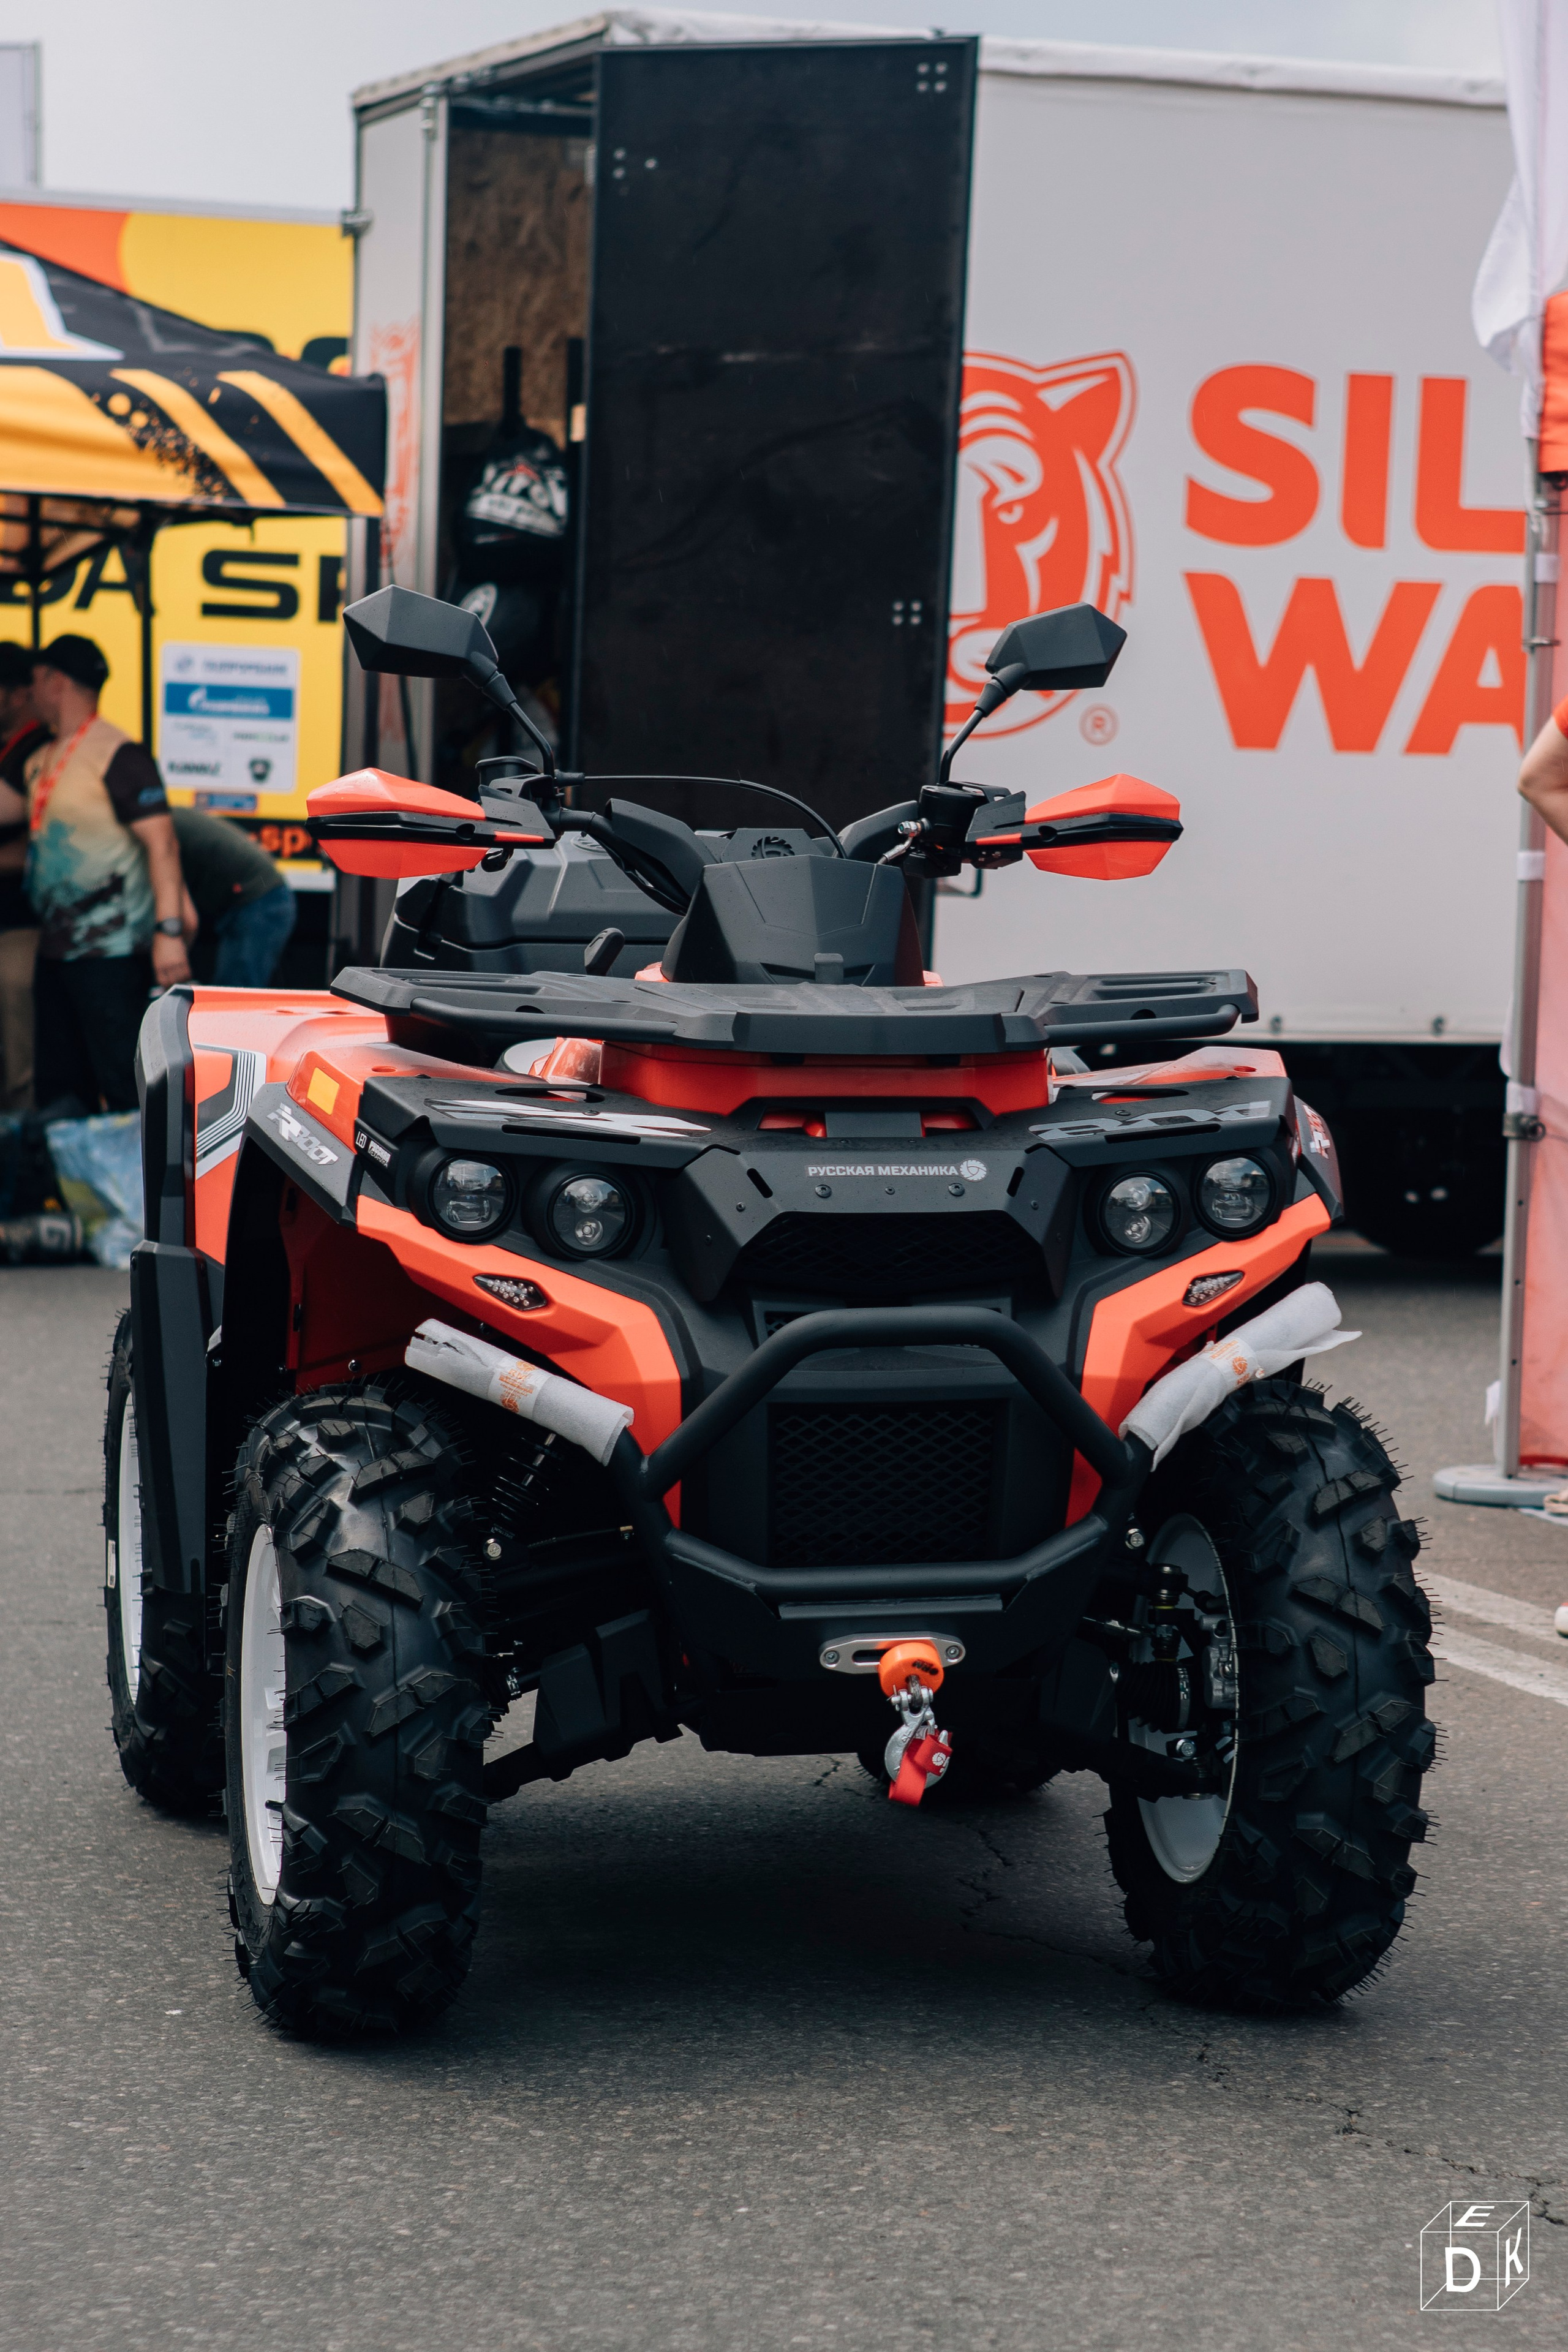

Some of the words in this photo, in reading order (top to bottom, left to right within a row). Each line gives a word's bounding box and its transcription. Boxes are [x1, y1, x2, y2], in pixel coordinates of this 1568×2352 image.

[355, 1131, 368, 1149] LED
[808, 1165, 874, 1177] РУССКАЯ
[878, 1165, 959, 1176] МЕХАНИКА
